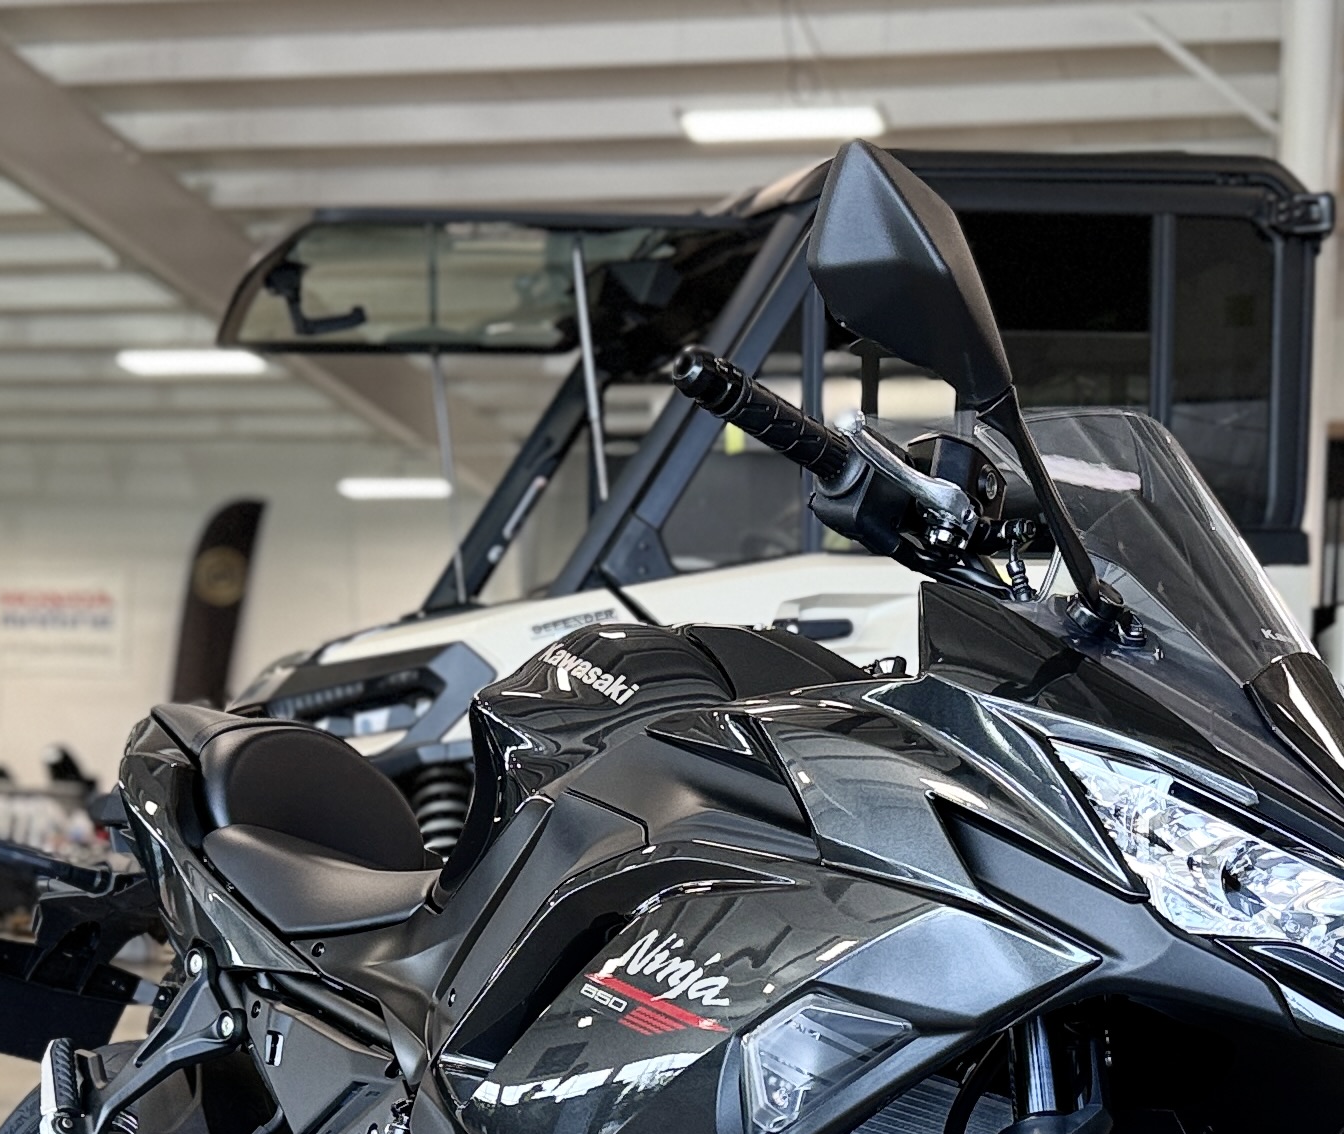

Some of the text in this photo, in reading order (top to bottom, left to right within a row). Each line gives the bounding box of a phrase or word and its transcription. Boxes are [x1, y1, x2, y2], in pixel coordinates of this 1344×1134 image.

[538, 643, 640, 706] Kawasaki
[580, 983, 628, 1013] 650
[599, 929, 730, 1006] Ninja
